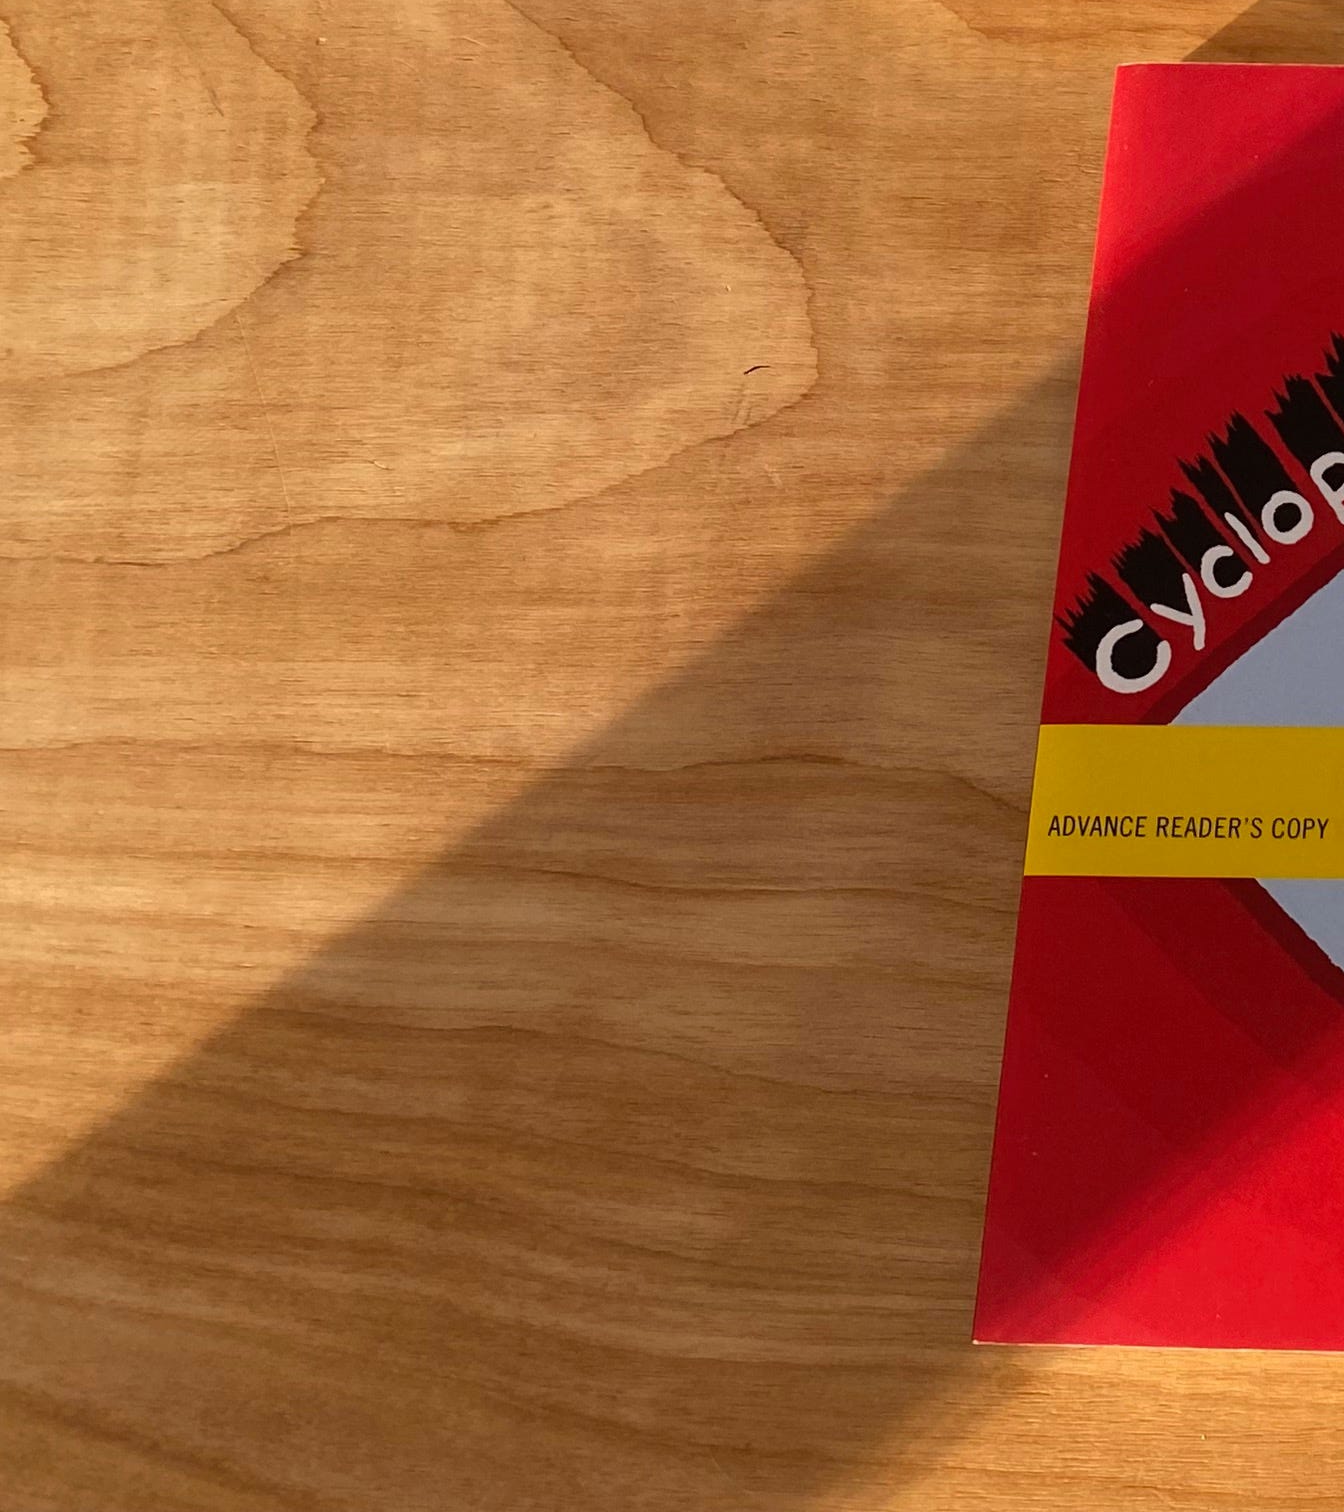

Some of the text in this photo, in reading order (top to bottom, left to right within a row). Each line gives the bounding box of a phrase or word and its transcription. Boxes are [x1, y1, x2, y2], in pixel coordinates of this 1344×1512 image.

[1047, 815, 1148, 839] ADVANCE
[1155, 815, 1263, 840] READER'S
[1271, 817, 1331, 840] COPY
